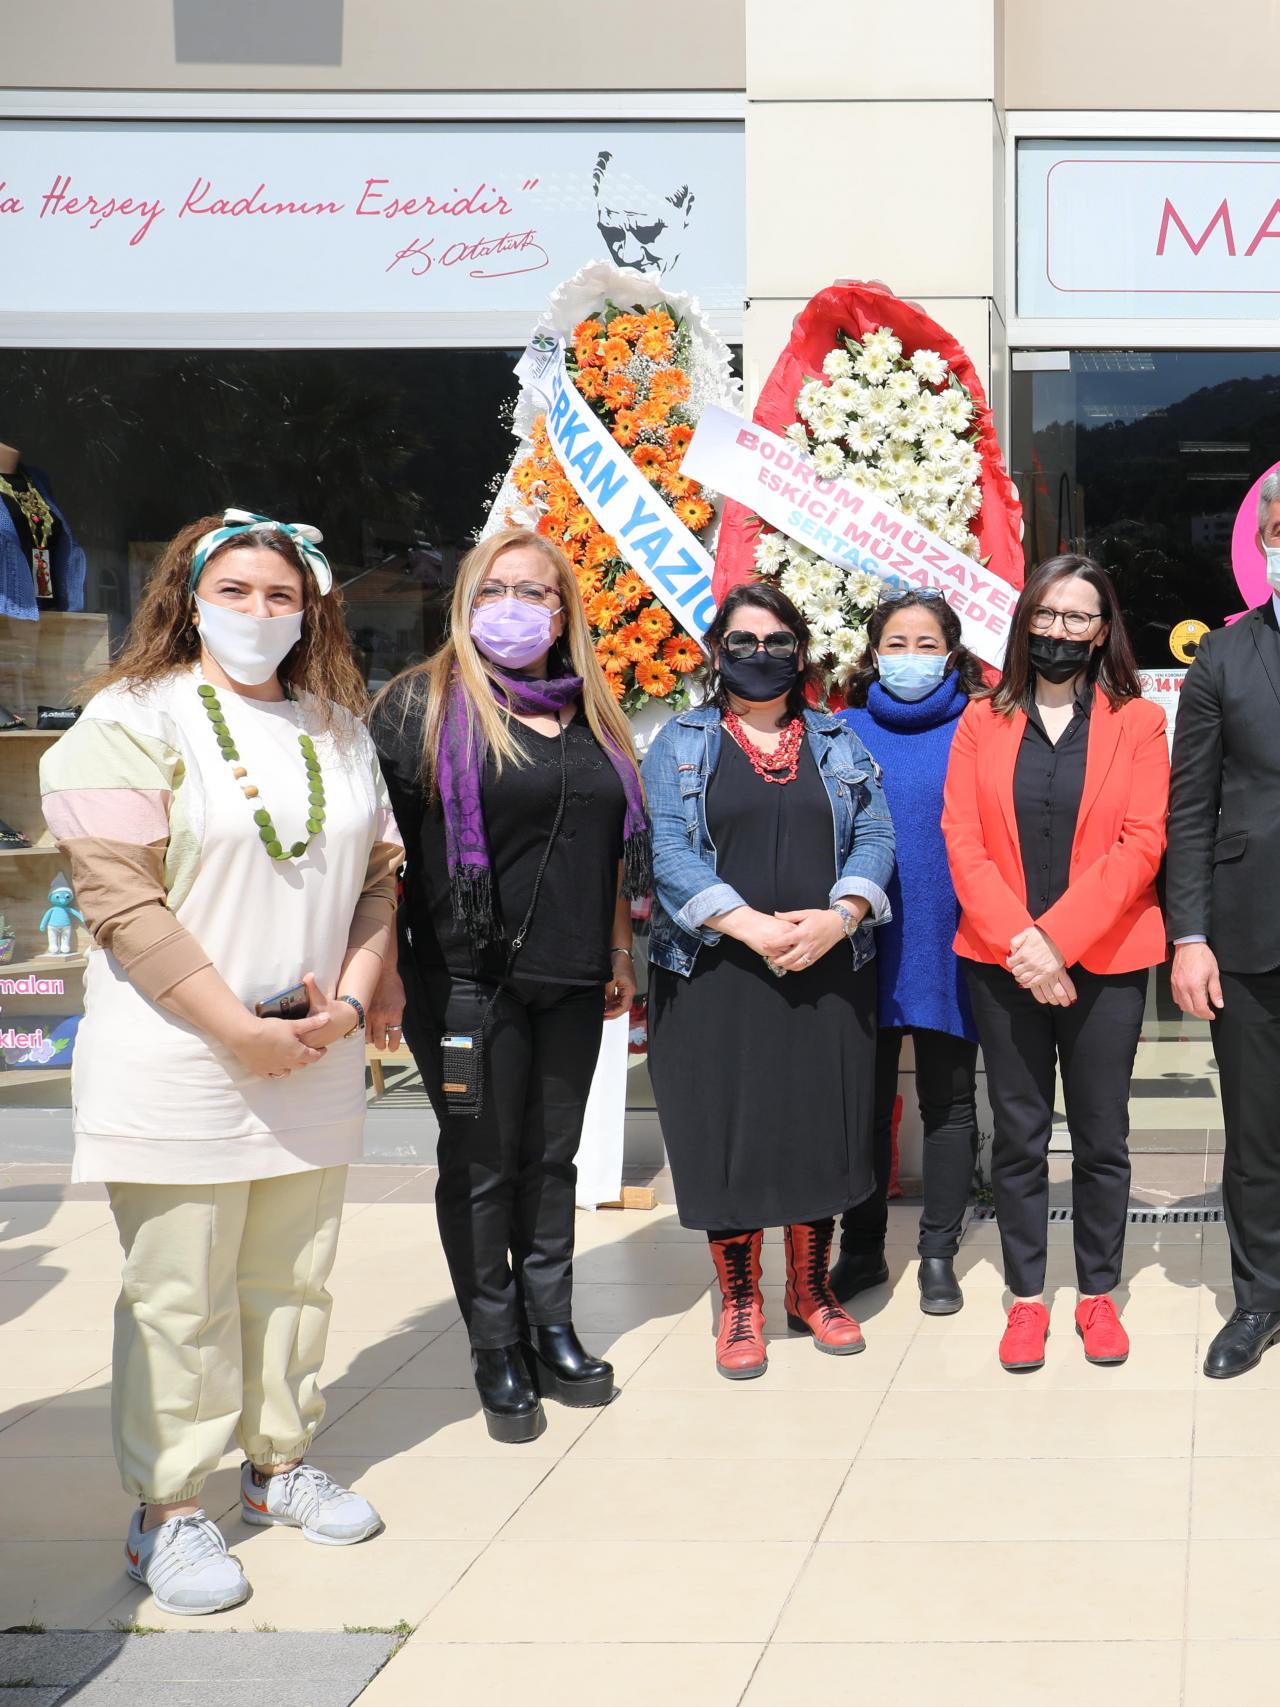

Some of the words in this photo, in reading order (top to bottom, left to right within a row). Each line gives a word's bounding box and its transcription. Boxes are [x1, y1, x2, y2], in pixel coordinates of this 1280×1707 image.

[0, 182, 24, 214] a
[40, 175, 165, 247] Herşey
[178, 177, 345, 219] Kadının
[735, 428, 865, 516] BODRUM
[756, 466, 840, 526] ESKİCİ
[1155, 678, 1172, 692] 14
